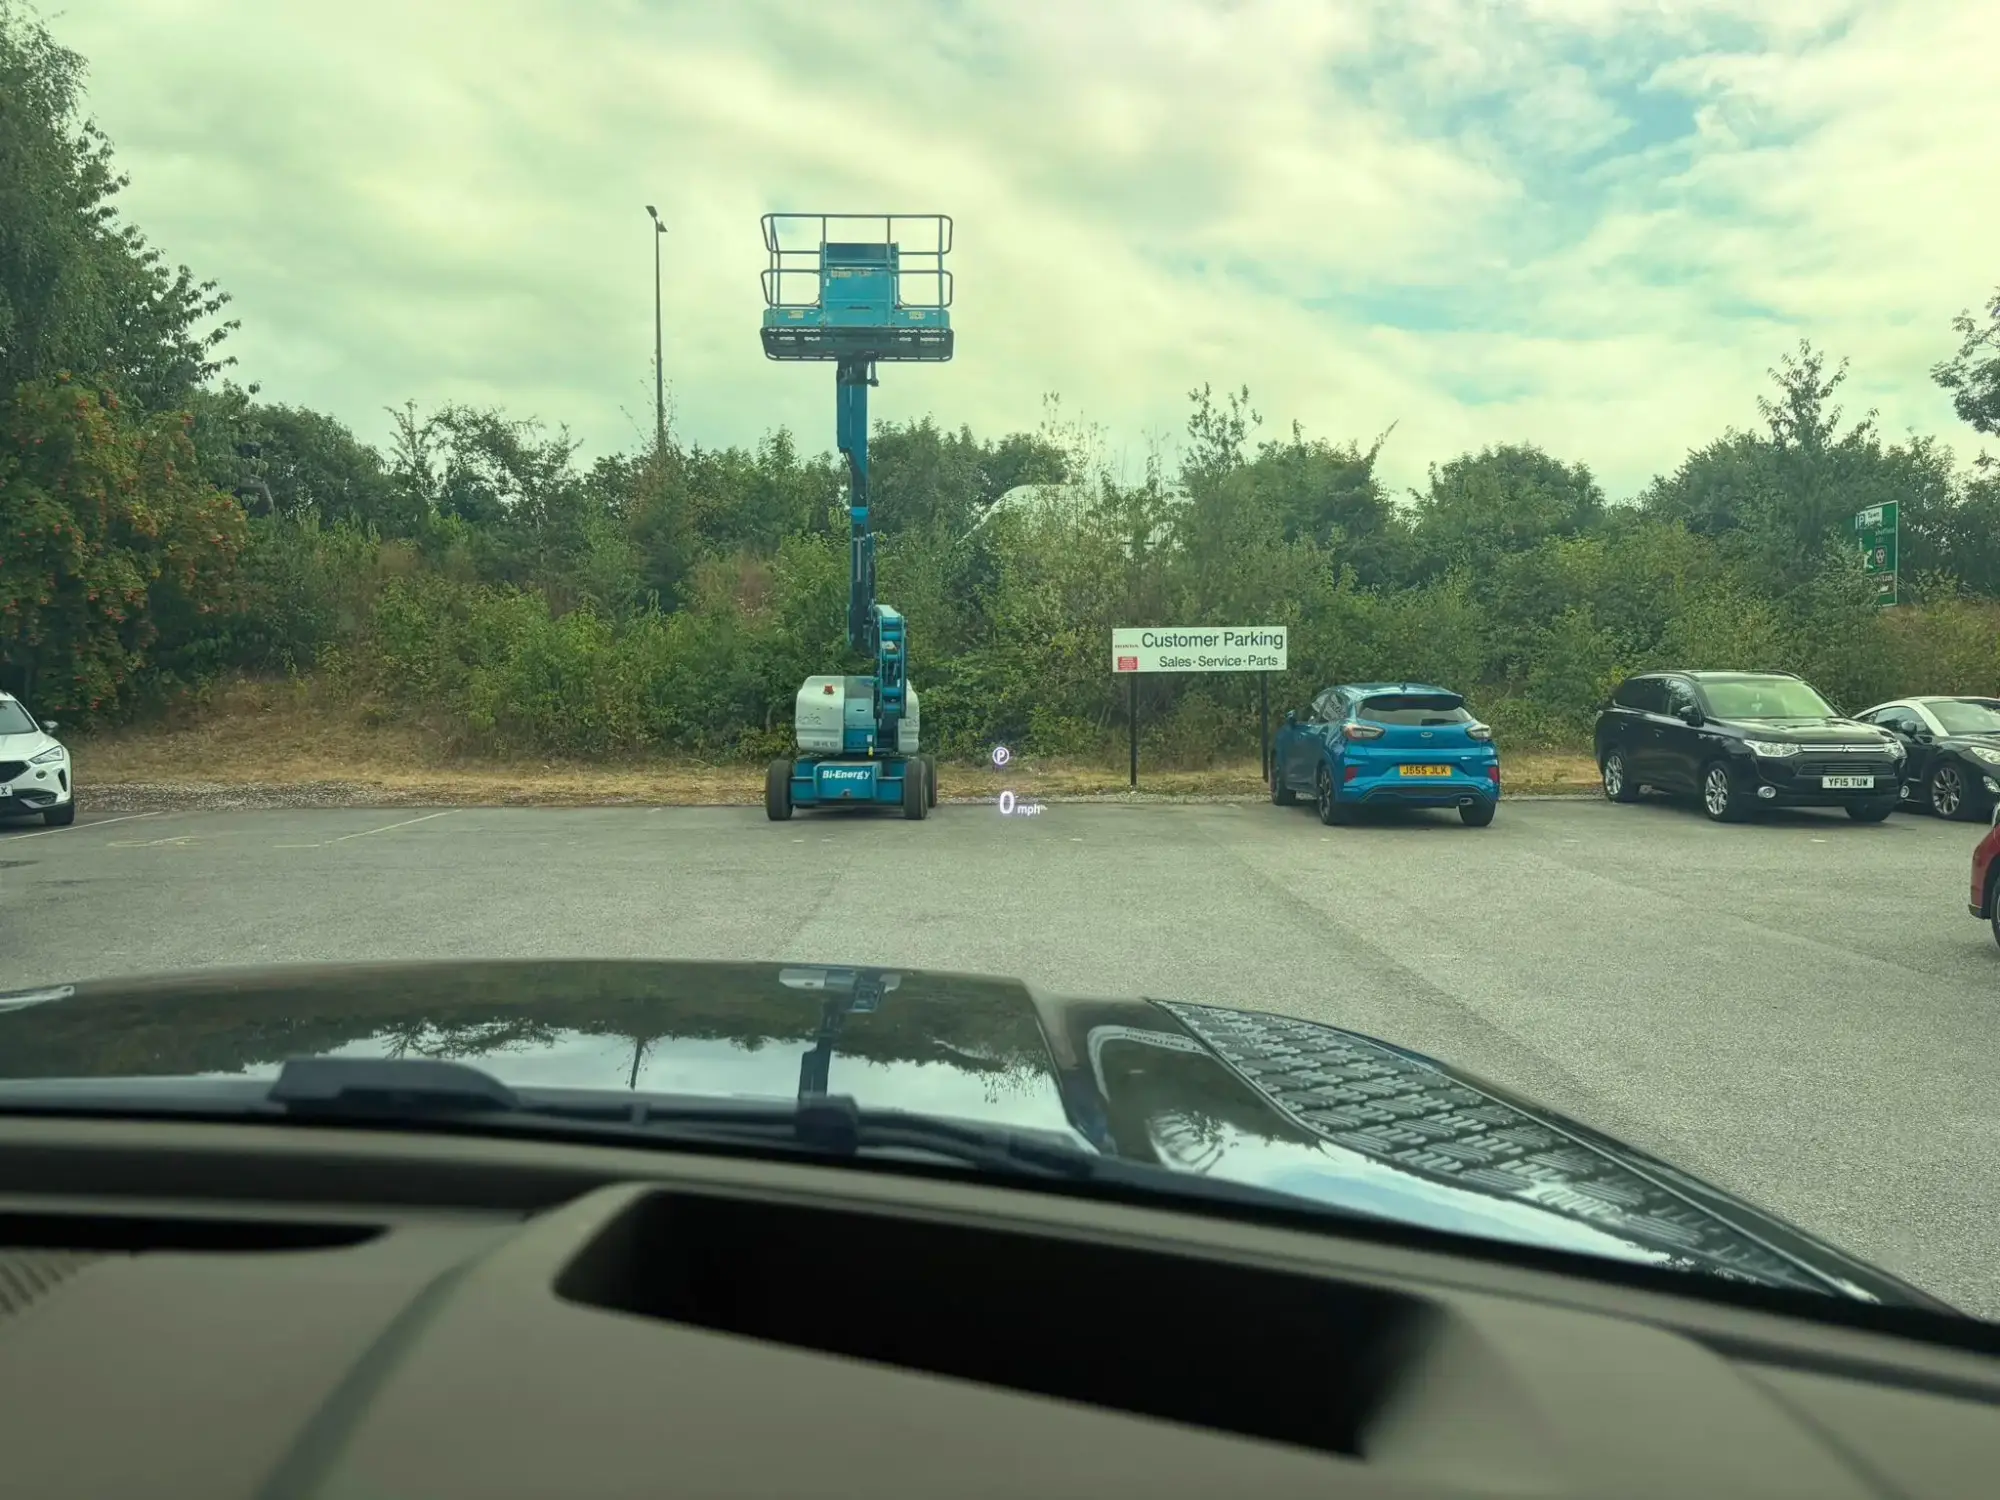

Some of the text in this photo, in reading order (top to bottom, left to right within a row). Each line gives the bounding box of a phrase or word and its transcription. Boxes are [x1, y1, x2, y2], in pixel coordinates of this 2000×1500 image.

[1141, 631, 1284, 650] Customer Parking
[1159, 655, 1278, 668] Sales Service Parts
[822, 770, 870, 780] Bi-Energy
[1000, 791, 1041, 816] 0 mph
